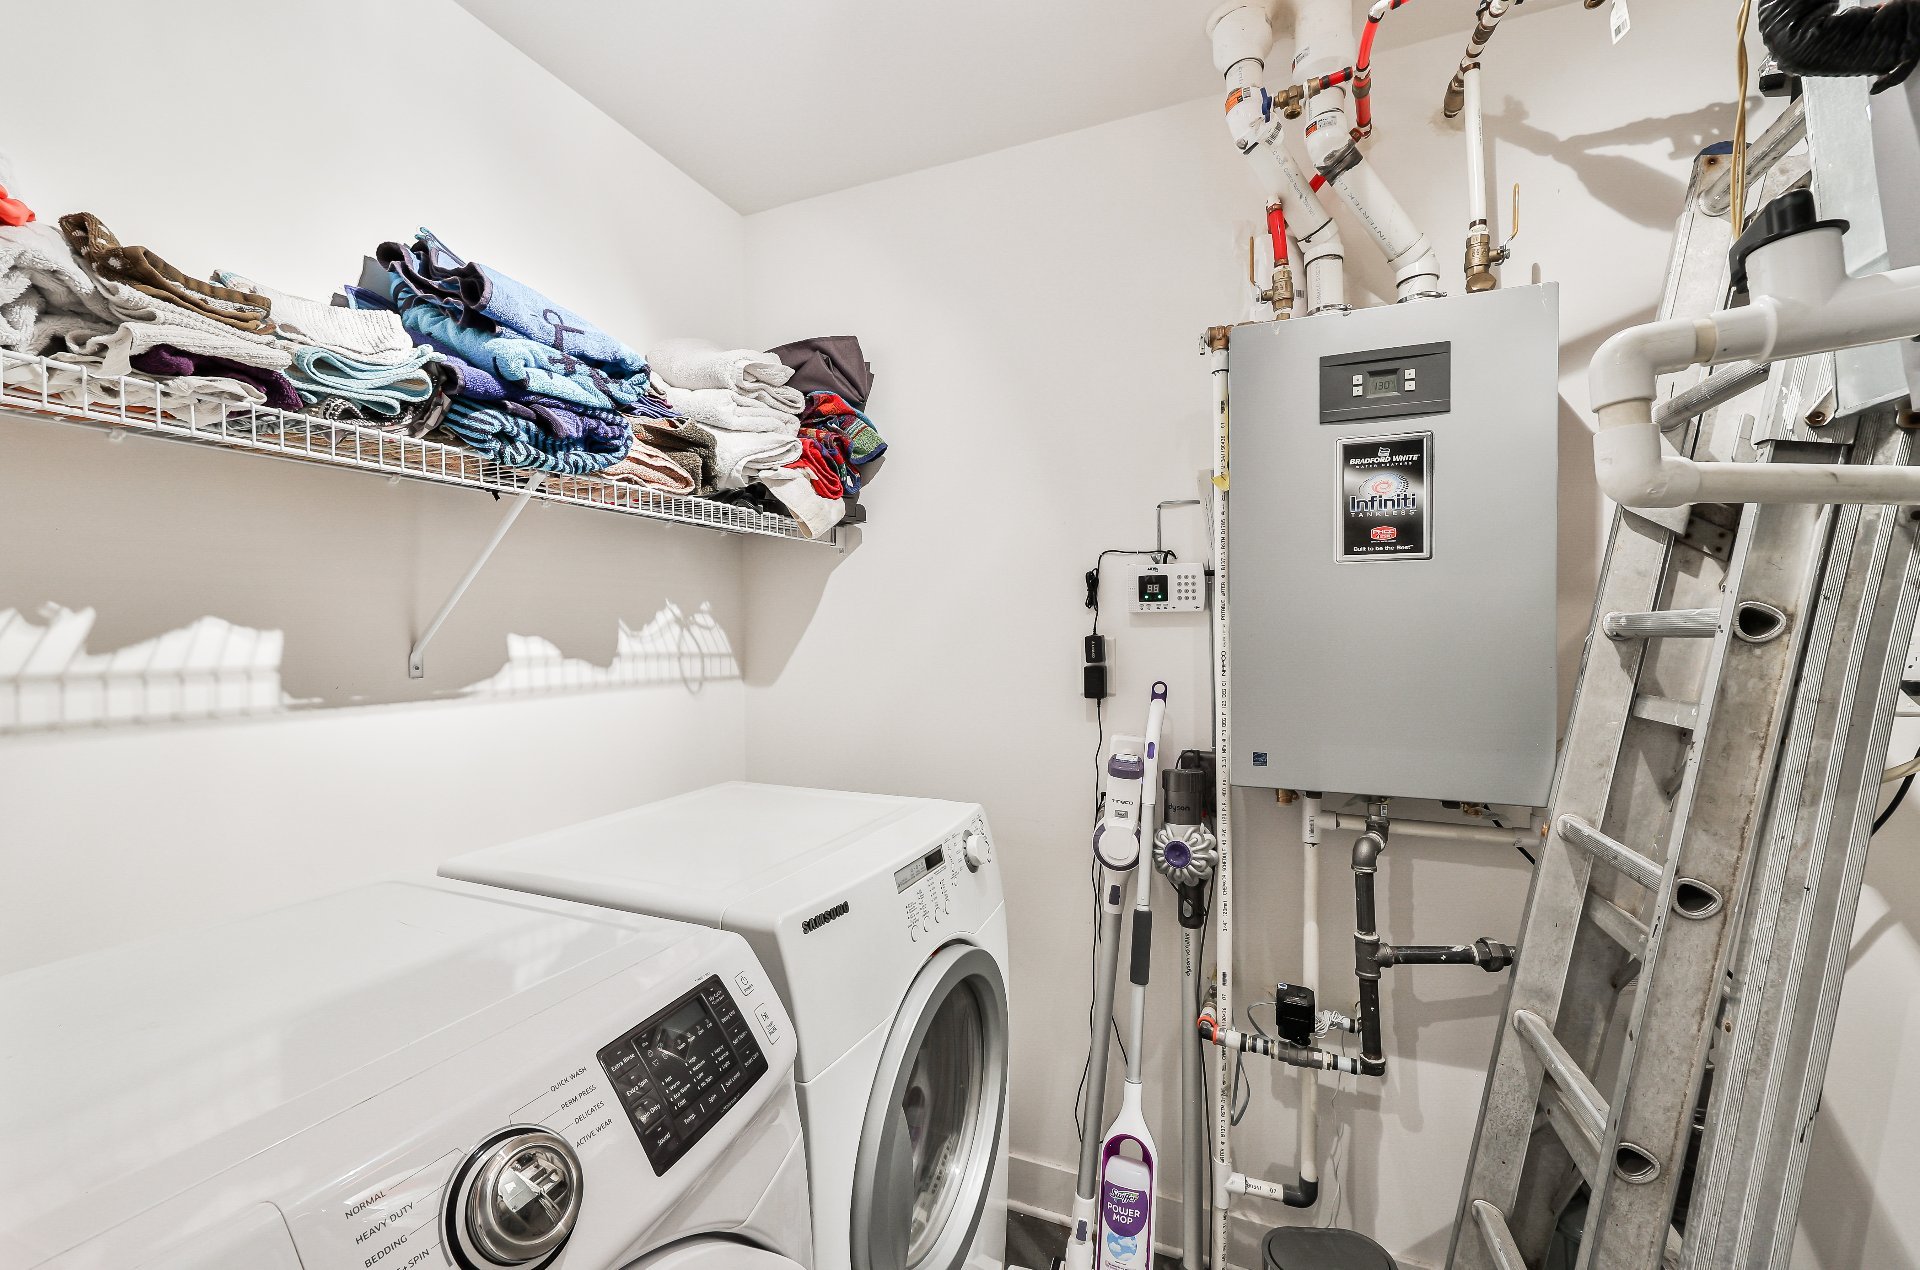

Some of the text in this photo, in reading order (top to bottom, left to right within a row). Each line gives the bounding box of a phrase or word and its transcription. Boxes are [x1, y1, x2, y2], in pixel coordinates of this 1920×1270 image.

[1348, 193, 1386, 241] INTERTEK
[1350, 454, 1419, 465] BRADFORD WHITE
[1350, 494, 1416, 512] Infiniti
[1351, 510, 1415, 518] TANKLESS
[1169, 803, 1191, 813] dyson
[801, 901, 850, 934] SAMSUNG
[611, 1053, 636, 1072] Extra Rinse
[551, 1067, 587, 1092] QUICK WASH
[626, 1079, 649, 1097] Extra Spin
[560, 1084, 597, 1110] PERM PRESS
[575, 1100, 605, 1125] DELICATES
[640, 1103, 661, 1122] Spin Only
[576, 1119, 613, 1148] ACTIVE WEAR
[657, 1132, 671, 1146] Sound
[345, 1190, 387, 1219] NORMAL
[1110, 1188, 1139, 1203] Swiffer
[1108, 1202, 1140, 1218] POWER
[1113, 1213, 1133, 1225] MOP
[355, 1202, 414, 1245] HEAVY DUTY
[364, 1234, 408, 1268] BEDDING
[407, 1249, 430, 1268] SPIN
